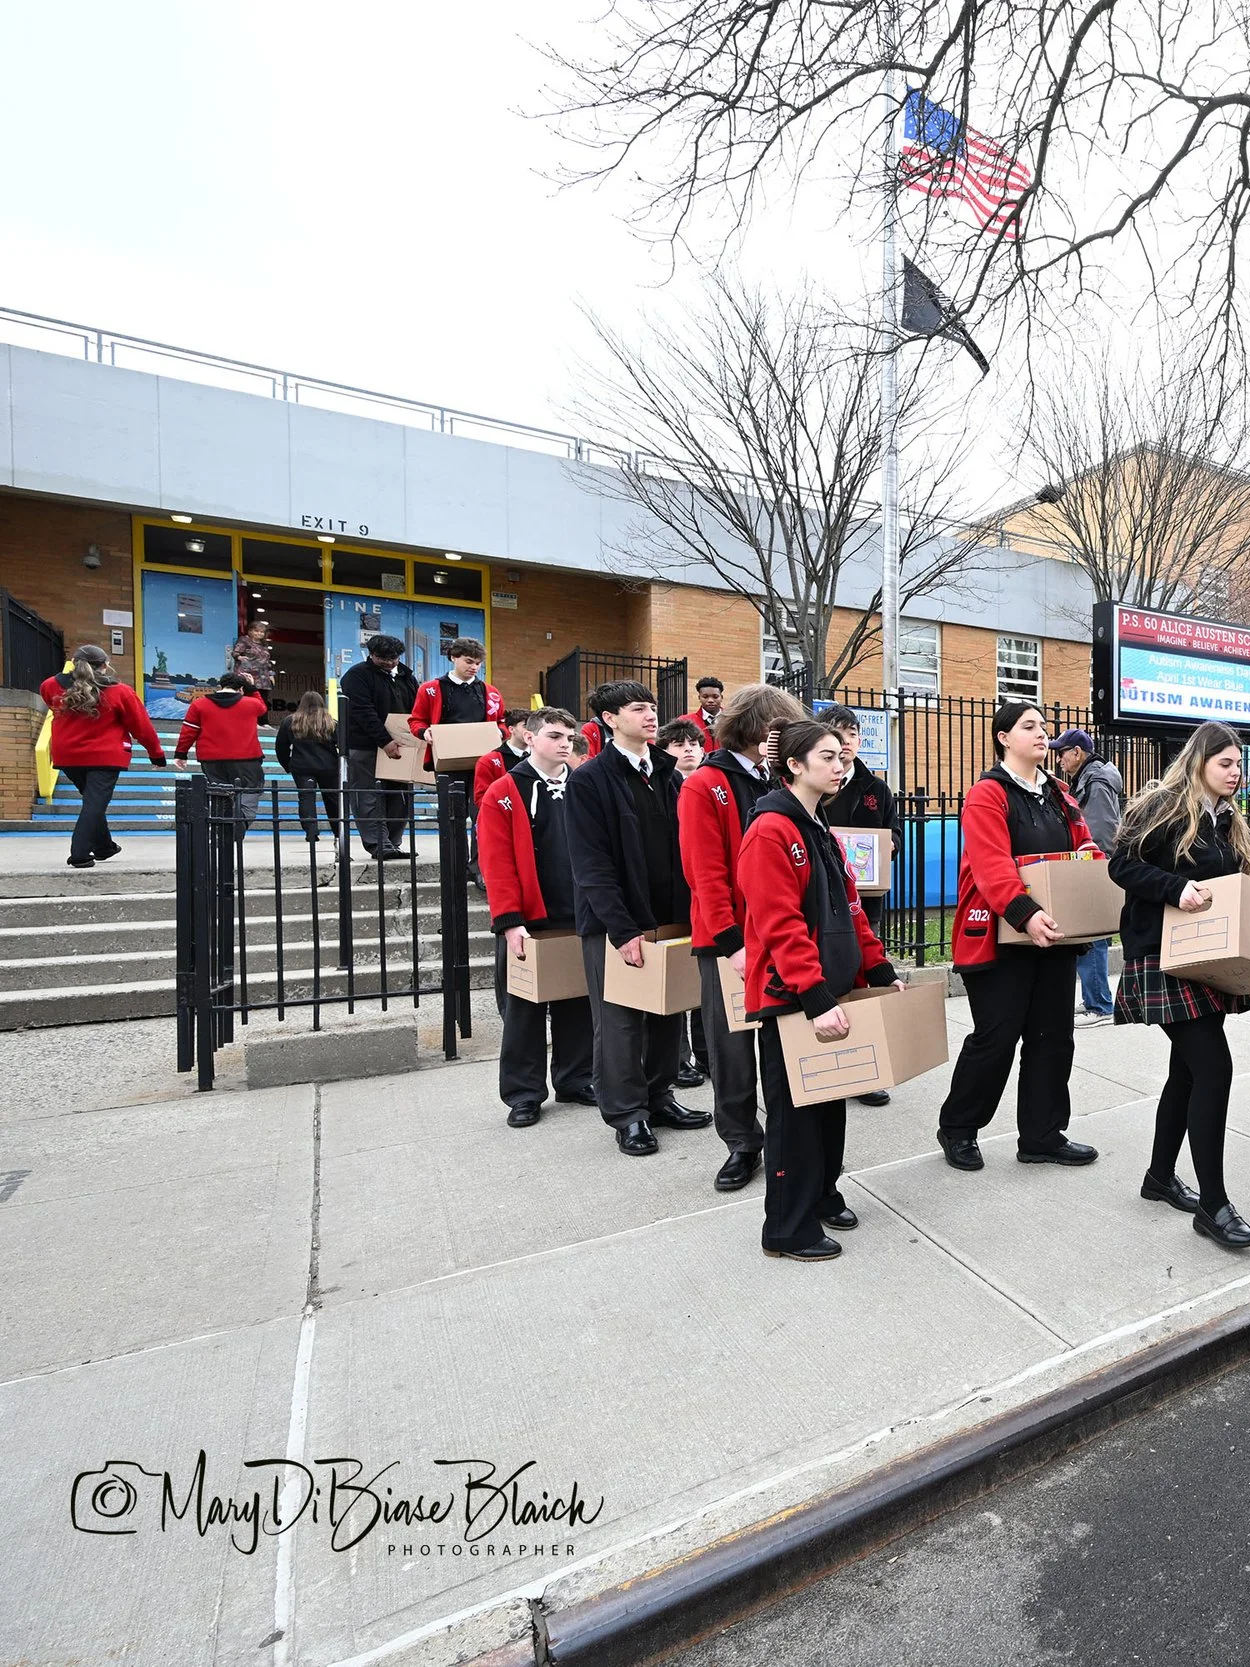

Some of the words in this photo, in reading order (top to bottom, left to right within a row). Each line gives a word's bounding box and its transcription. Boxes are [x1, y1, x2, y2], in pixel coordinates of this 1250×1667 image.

[301, 515, 347, 532] EXIT
[359, 525, 369, 536] 9
[1122, 613, 1142, 628] P.S.
[1144, 617, 1158, 630] 60
[1160, 620, 1192, 637] ALICE
[1195, 626, 1235, 643] AUSTEN
[1157, 635, 1187, 647] IMAGINE
[1192, 640, 1218, 652] BELIEVE
[1223, 645, 1250, 657] ACHIEVE
[1149, 655, 1182, 668] Autism
[1184, 660, 1234, 675] Awareness
[1157, 671, 1180, 684] April
[1182, 674, 1197, 686] 1st
[1198, 676, 1221, 688] Wear
[1224, 679, 1245, 692] Blue
